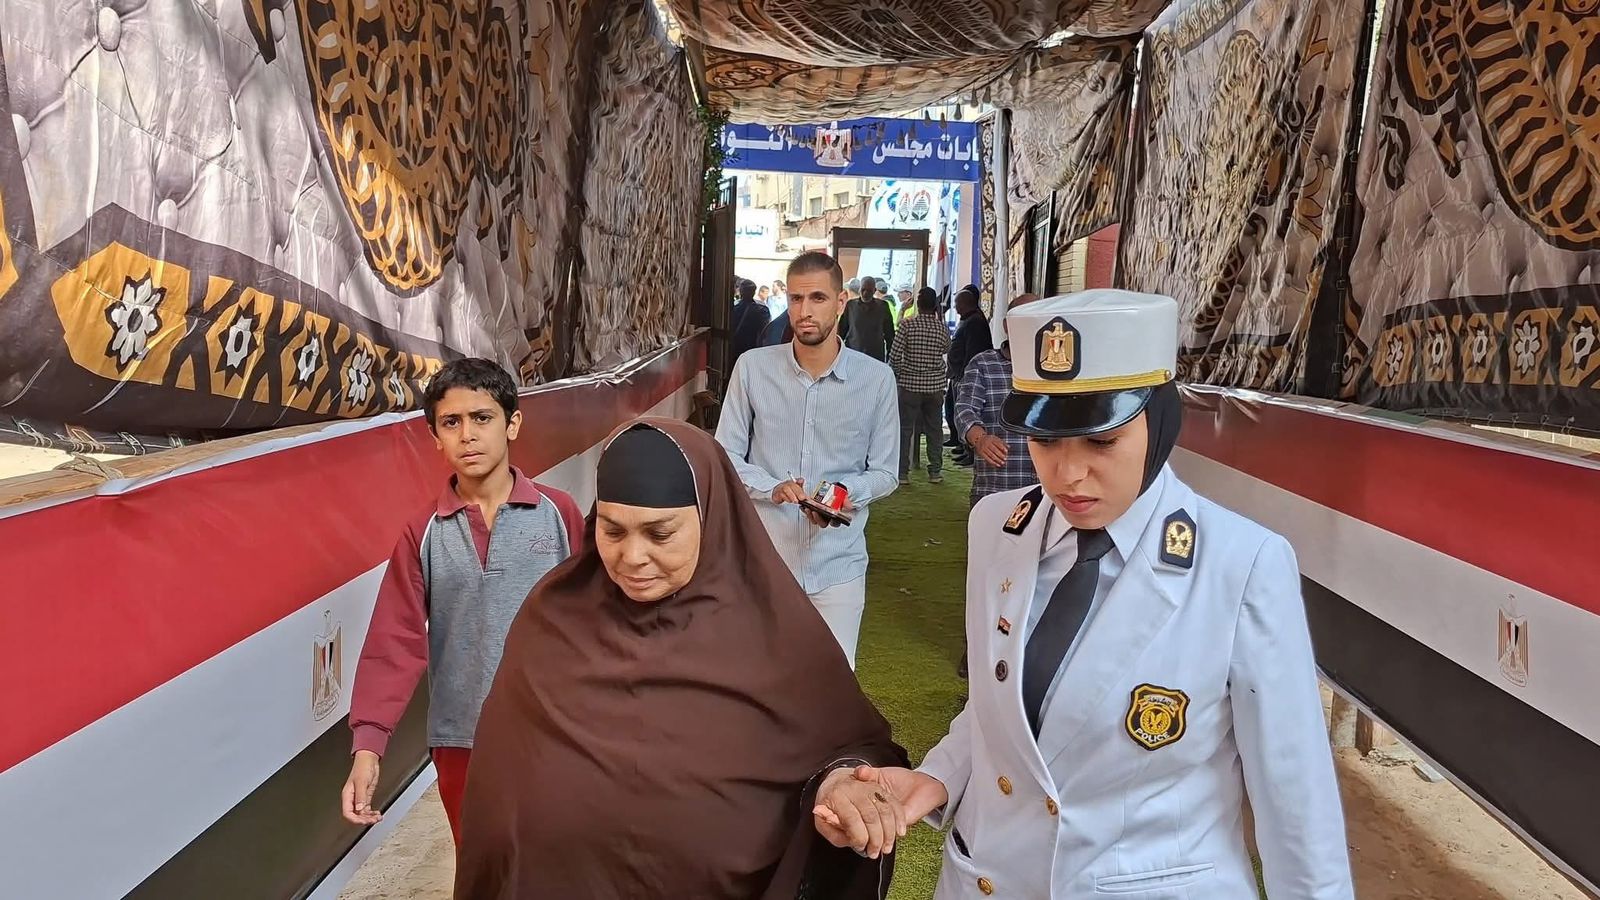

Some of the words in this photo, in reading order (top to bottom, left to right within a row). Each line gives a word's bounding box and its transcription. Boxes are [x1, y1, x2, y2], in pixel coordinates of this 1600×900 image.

[720, 125, 793, 156] النوا
[872, 133, 933, 166] مجلس
[937, 133, 980, 171] ابات
[735, 224, 769, 239] النياب
[1135, 728, 1170, 743] POLICE
